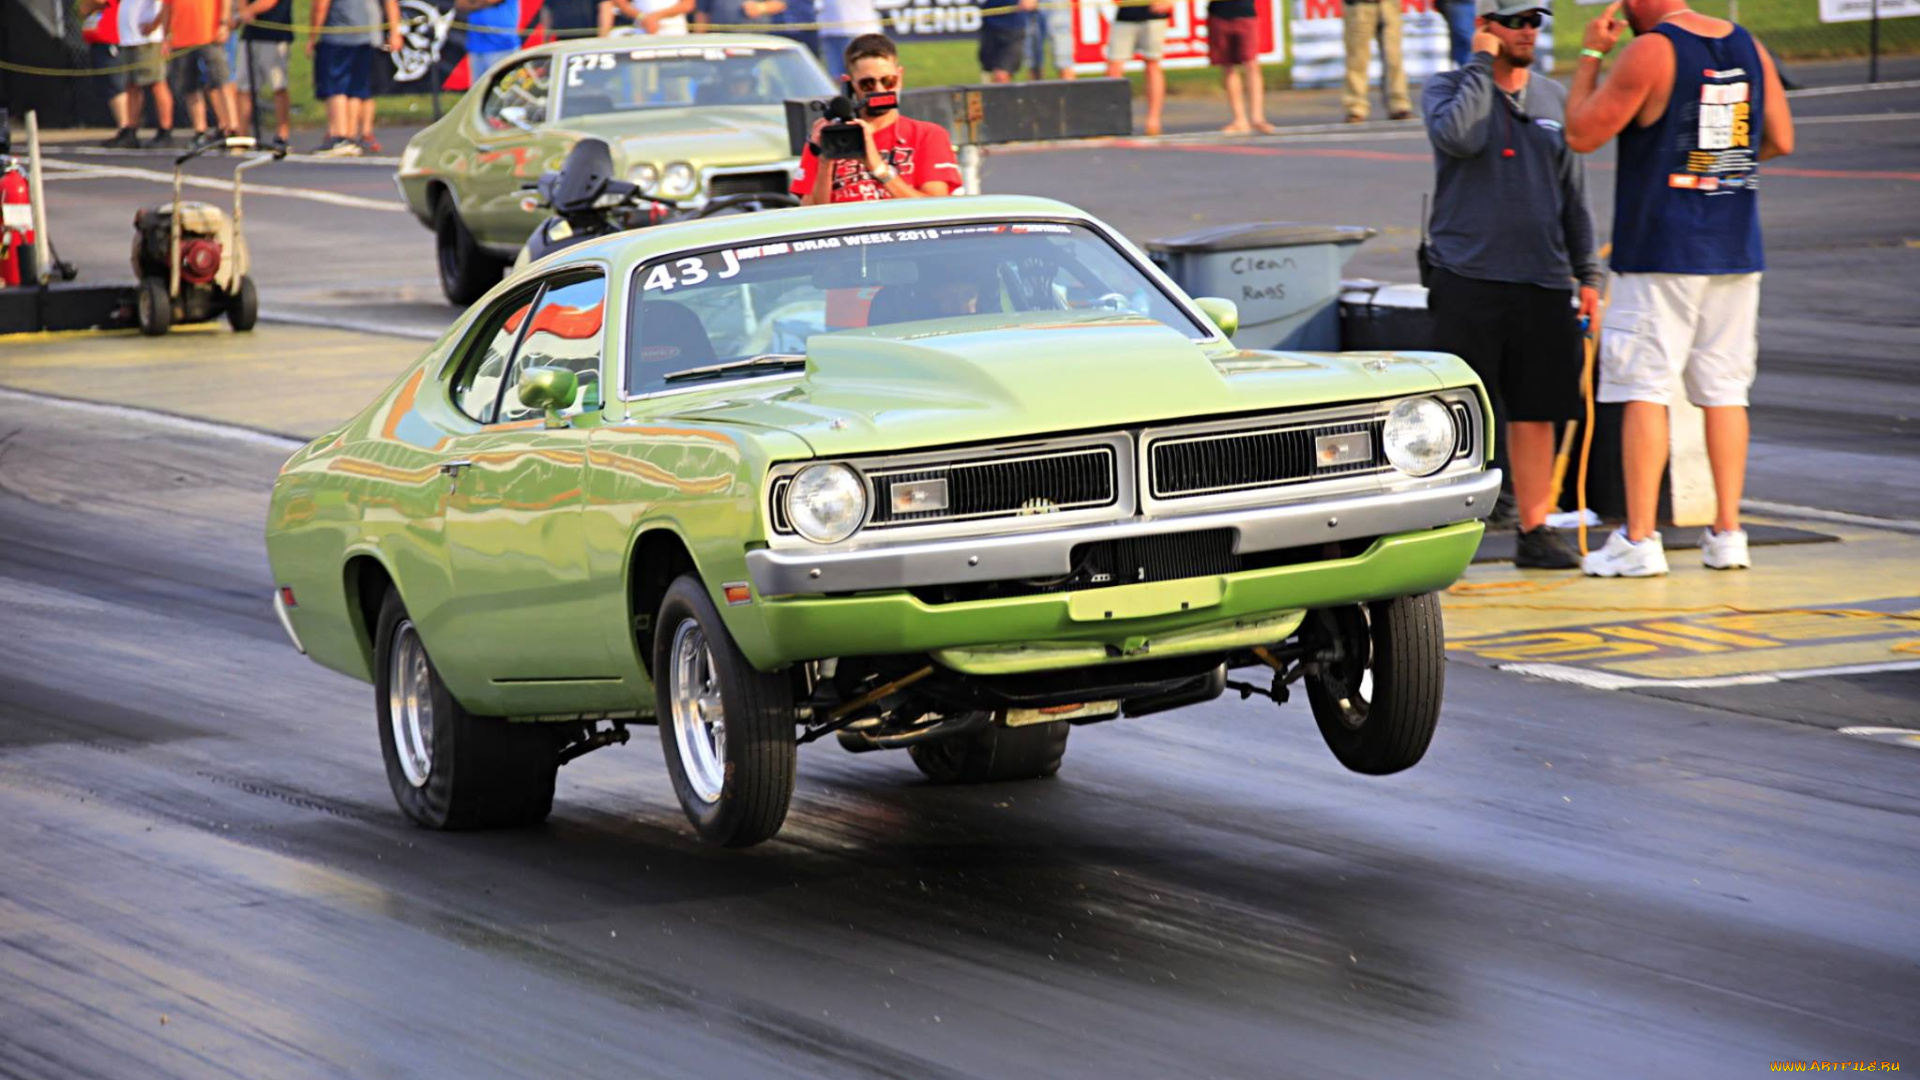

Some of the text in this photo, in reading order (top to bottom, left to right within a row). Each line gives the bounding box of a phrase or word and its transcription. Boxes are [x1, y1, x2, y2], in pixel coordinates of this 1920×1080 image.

[567, 53, 617, 70] 275
[792, 237, 841, 252] DRAG
[843, 231, 894, 246] WEEK
[897, 229, 940, 242] 2018
[643, 257, 709, 291] 43
[718, 249, 741, 279] J
[1230, 256, 1297, 275] Clean
